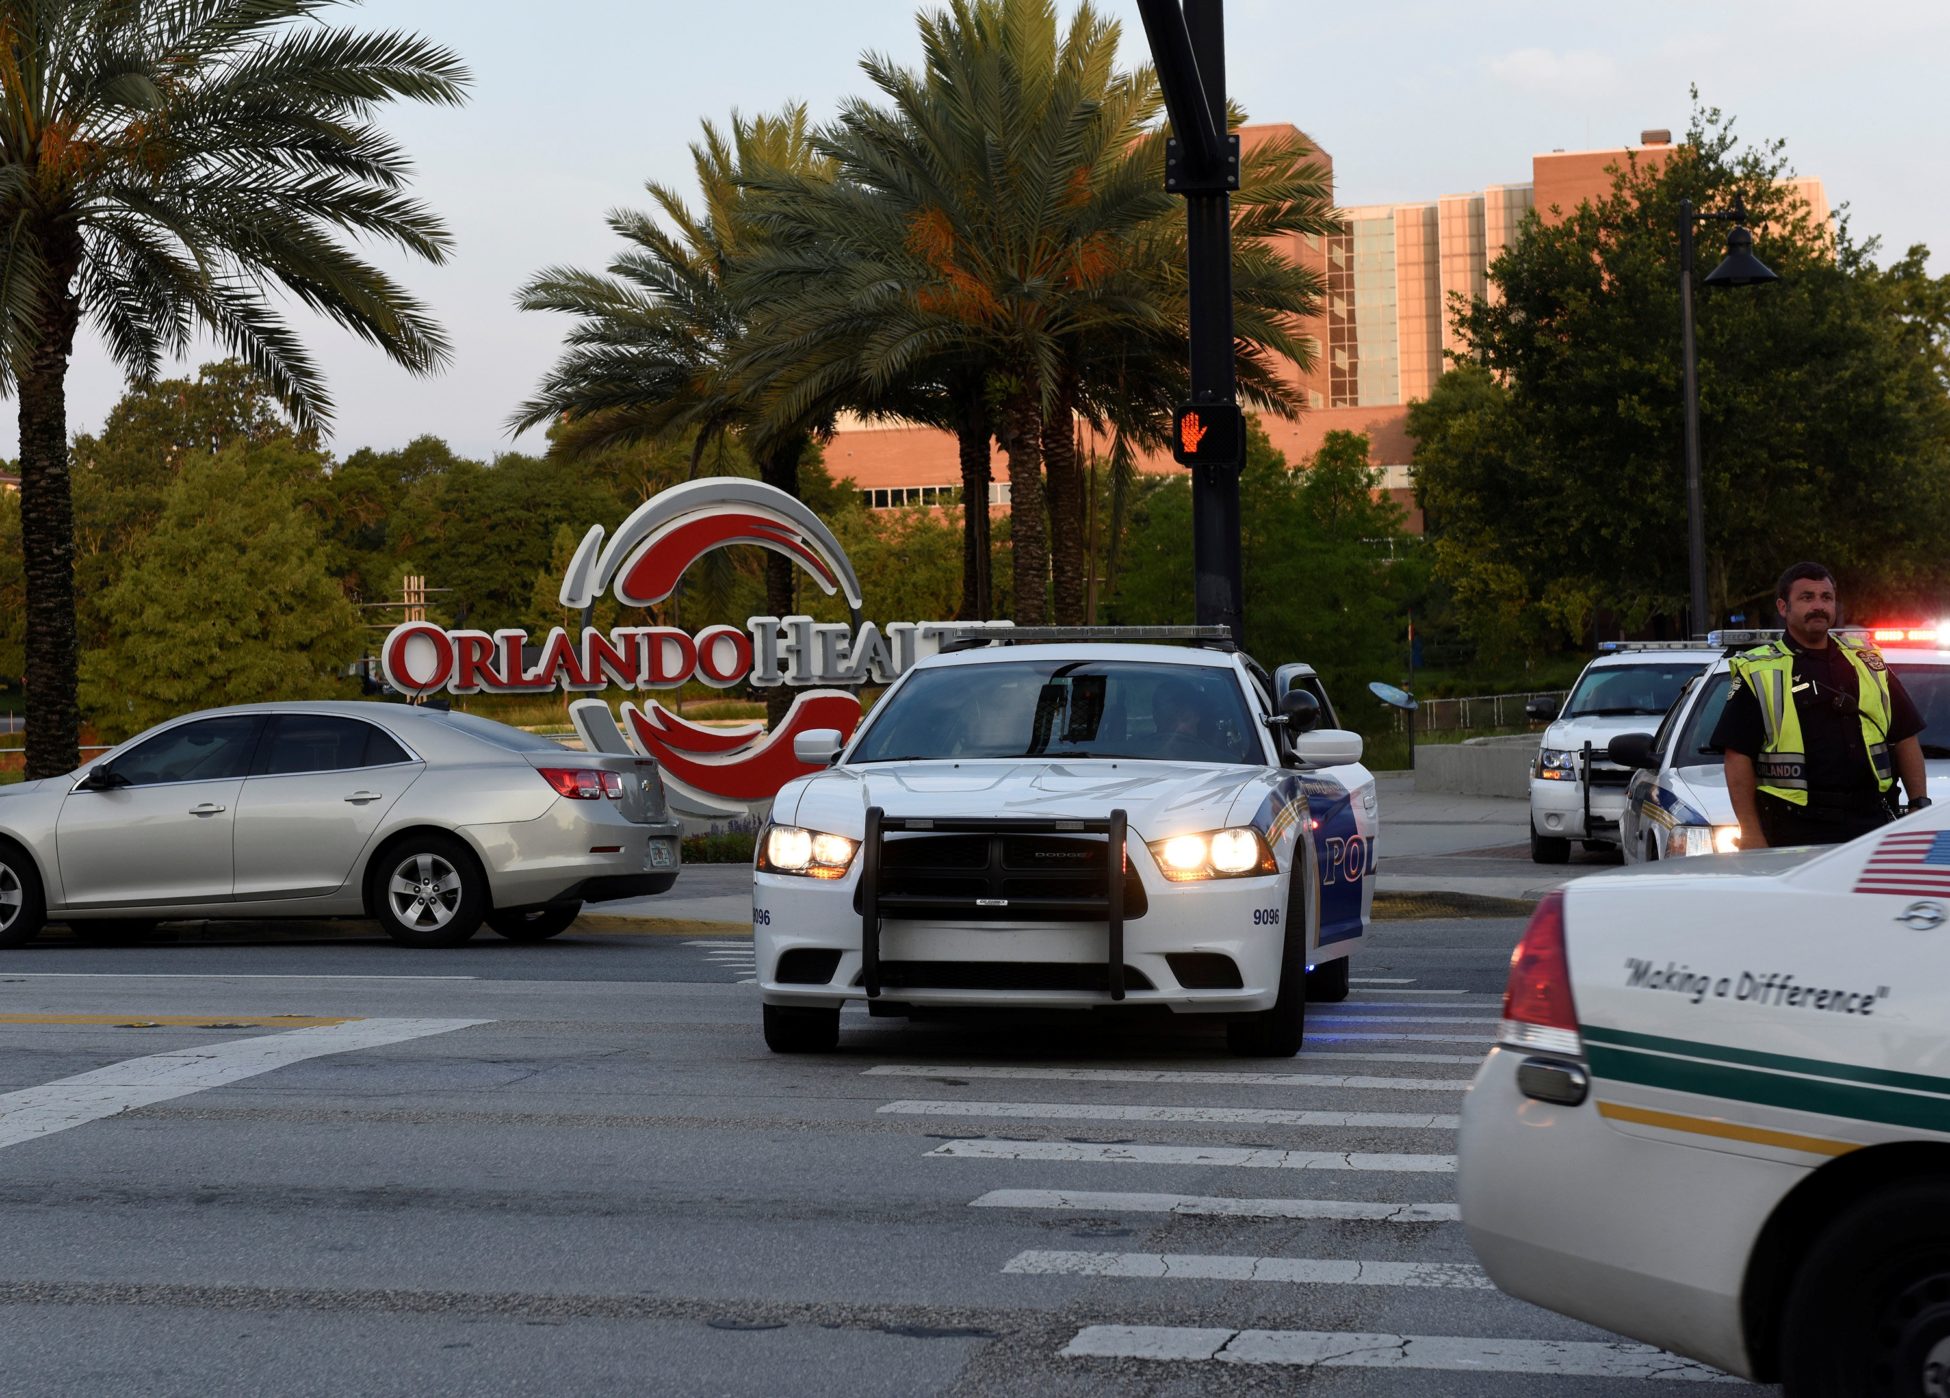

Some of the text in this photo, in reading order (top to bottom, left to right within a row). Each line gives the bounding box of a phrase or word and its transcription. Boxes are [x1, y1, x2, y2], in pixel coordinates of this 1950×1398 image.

[386, 623, 752, 692] ORLANDO
[1253, 908, 1280, 925] 9096
[1624, 957, 1890, 1016] "Making a Difference"
